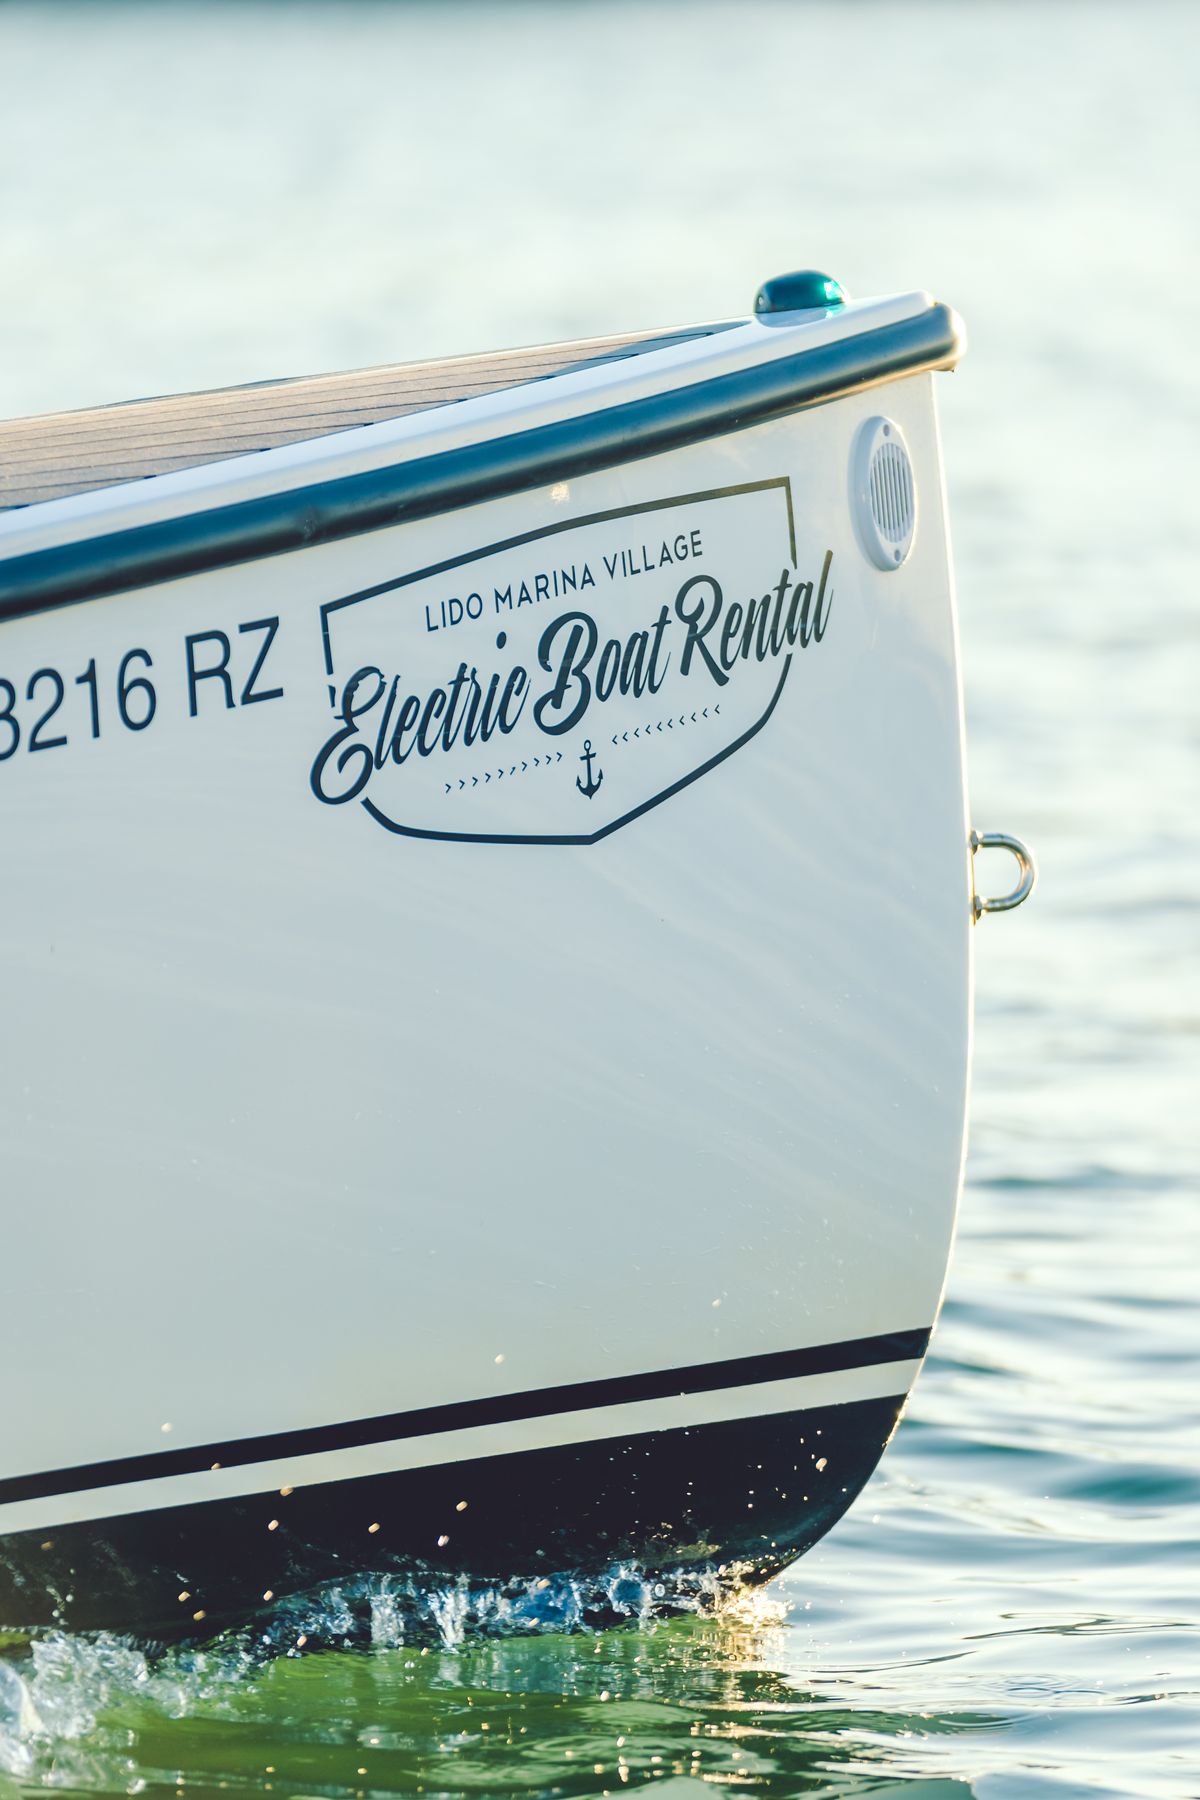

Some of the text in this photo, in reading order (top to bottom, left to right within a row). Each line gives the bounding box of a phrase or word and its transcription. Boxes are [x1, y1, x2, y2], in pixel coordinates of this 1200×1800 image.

[425, 529, 704, 633] LIDO MARINA VILLAGE
[184, 615, 284, 718] RZ
[309, 549, 834, 806] Electric Boat Rental
